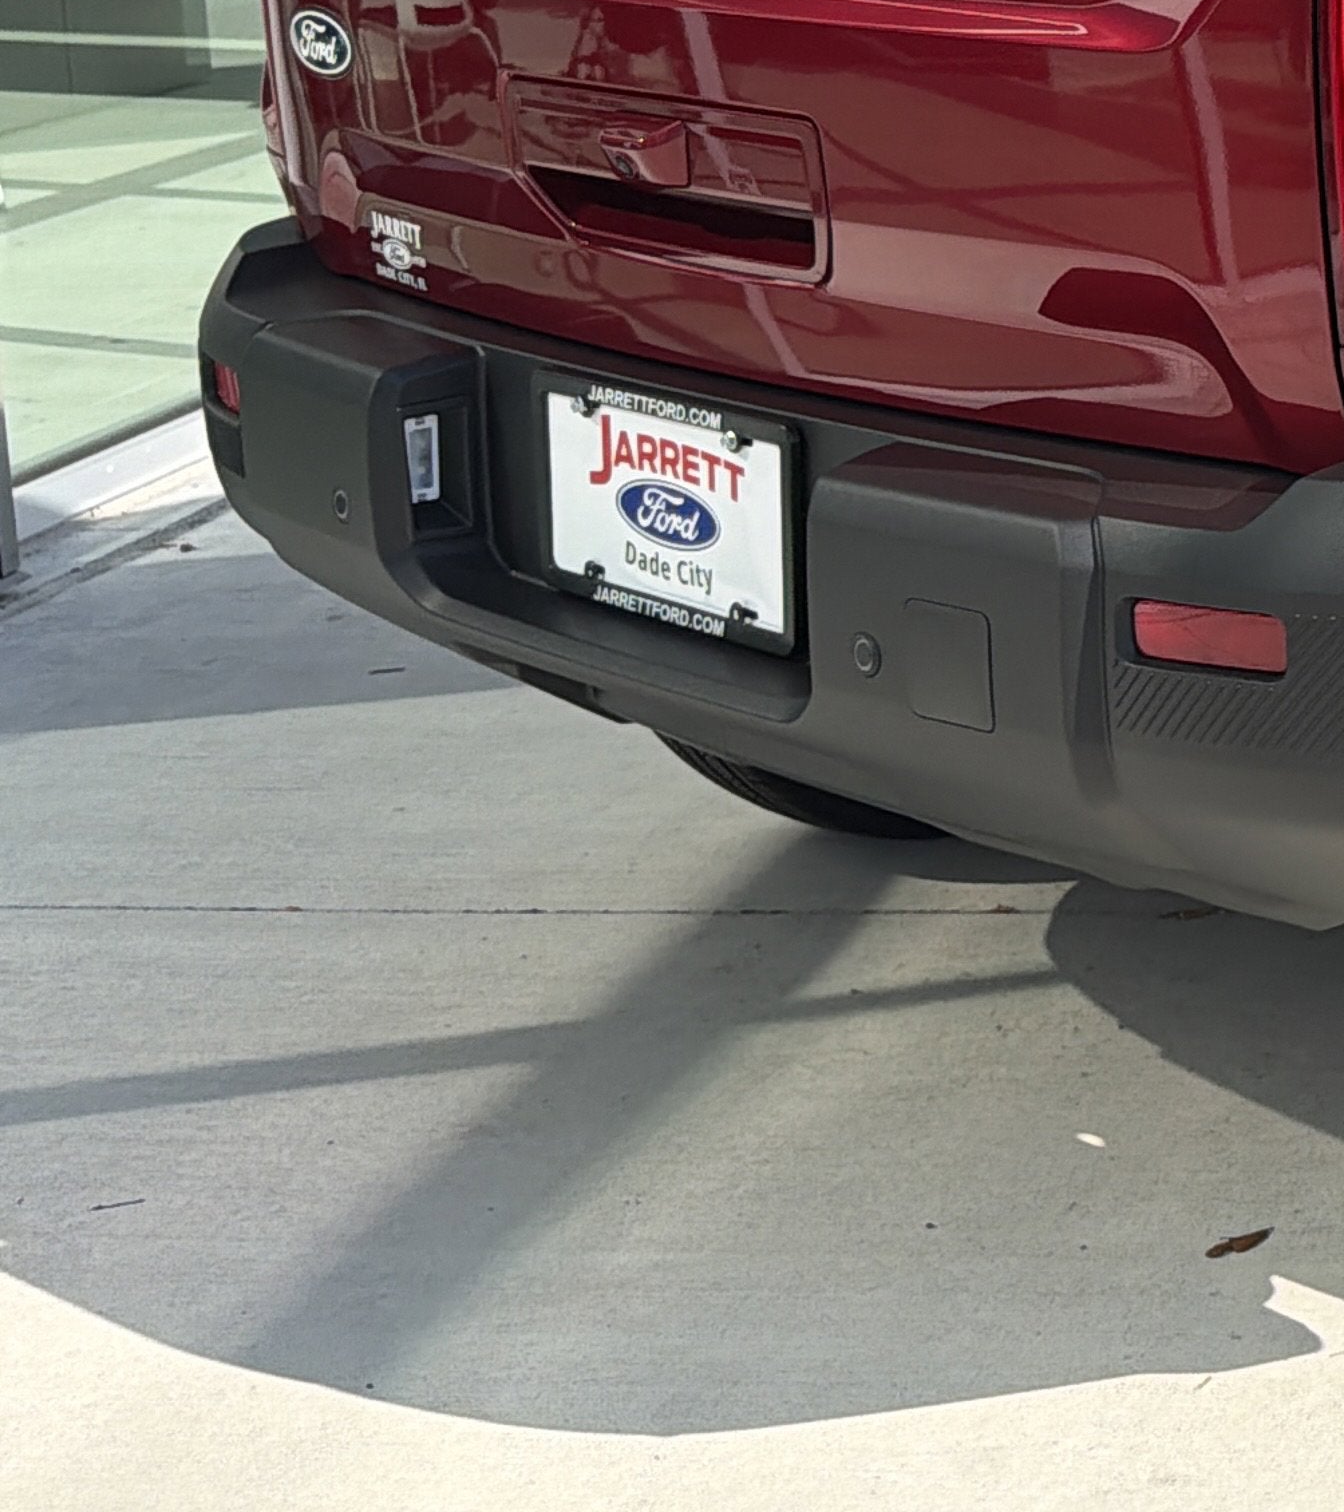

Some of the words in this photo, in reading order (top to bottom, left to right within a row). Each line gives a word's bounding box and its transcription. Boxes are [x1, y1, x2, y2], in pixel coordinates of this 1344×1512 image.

[299, 18, 339, 65] Ford
[370, 210, 421, 250] JARRETT
[588, 385, 722, 430] JARRETTFORD.COM
[589, 414, 745, 503] JARRETT
[636, 487, 701, 542] Ford
[625, 541, 671, 581] Dade
[677, 560, 713, 596] City
[593, 585, 726, 638] JARRETTFORD.COM
